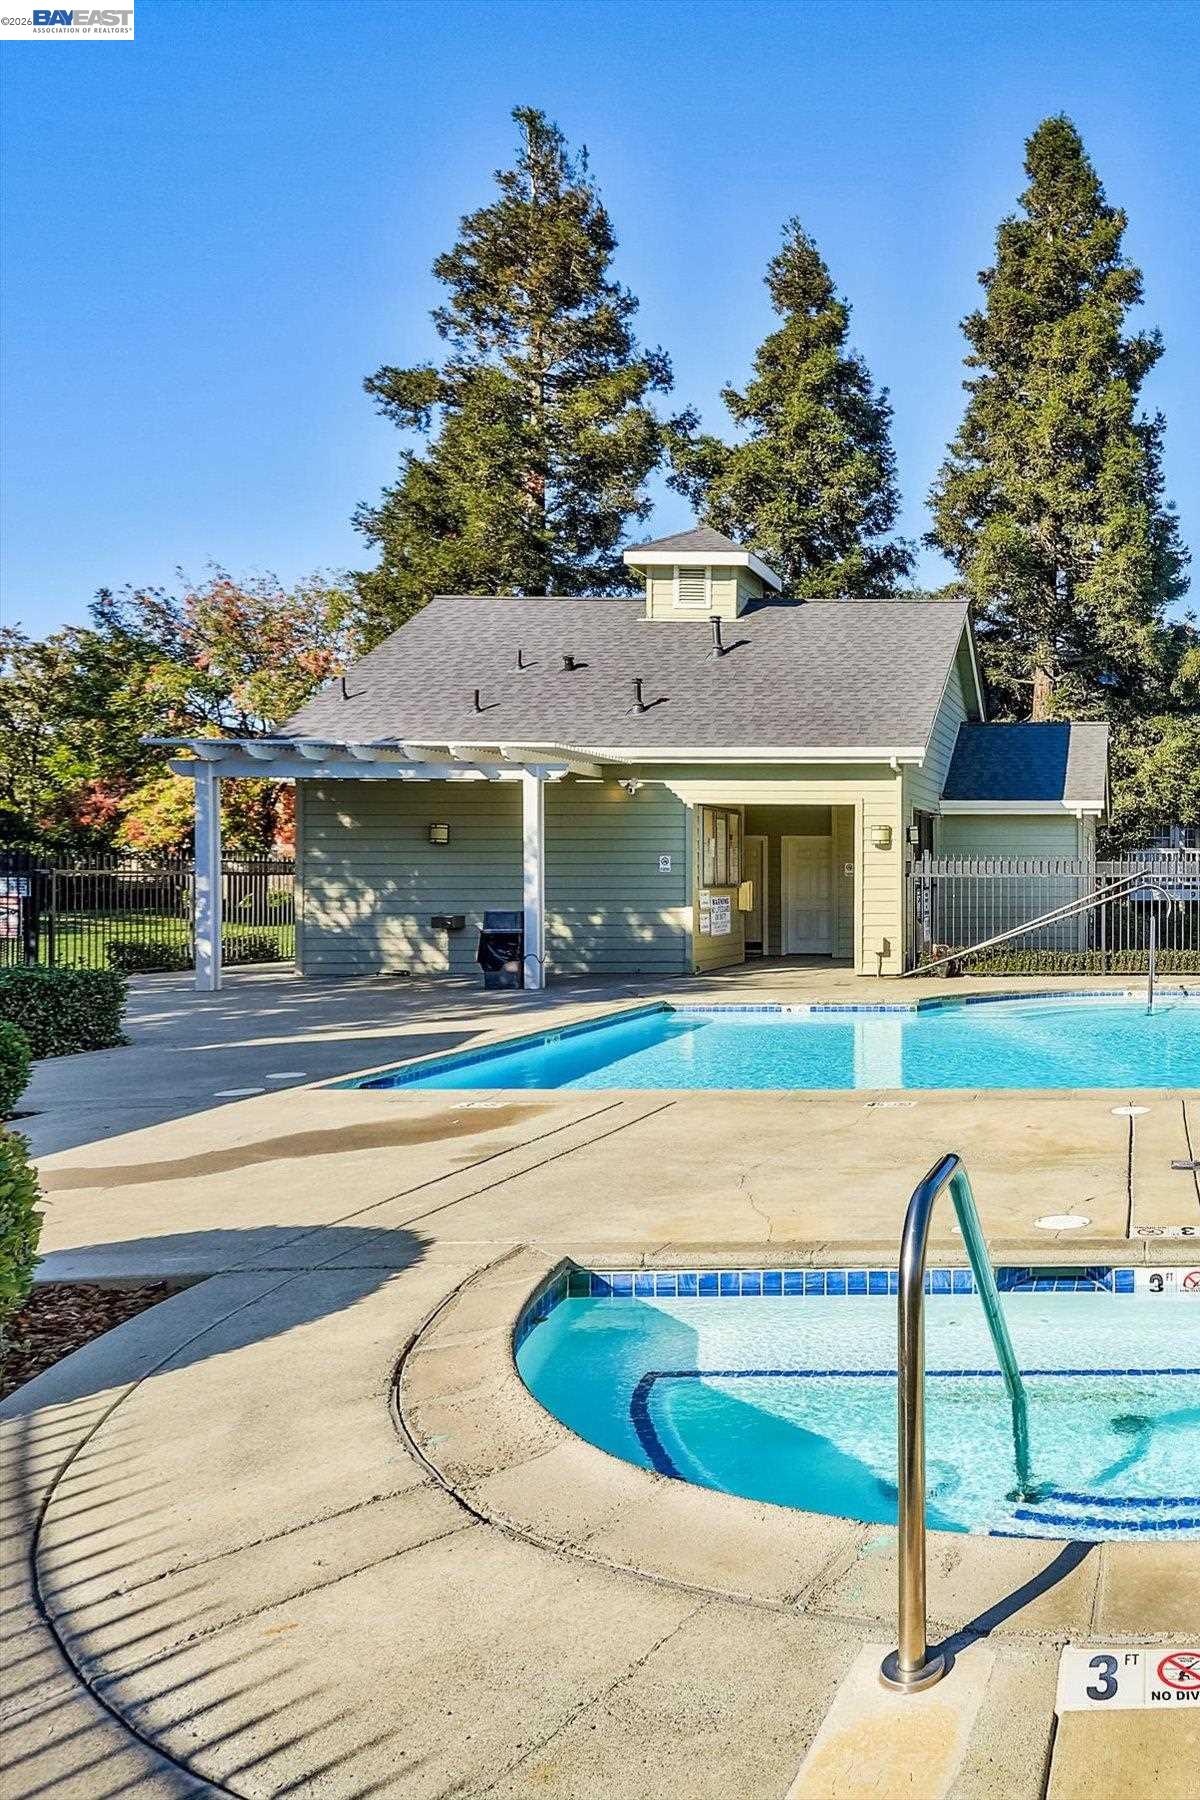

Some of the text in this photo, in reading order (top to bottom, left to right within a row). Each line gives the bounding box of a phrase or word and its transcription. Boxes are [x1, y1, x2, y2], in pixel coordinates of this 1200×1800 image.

[1149, 1272, 1173, 1292] 3 FT
[1086, 1654, 1140, 1701] 3 FT
[1151, 1691, 1171, 1701] NO
